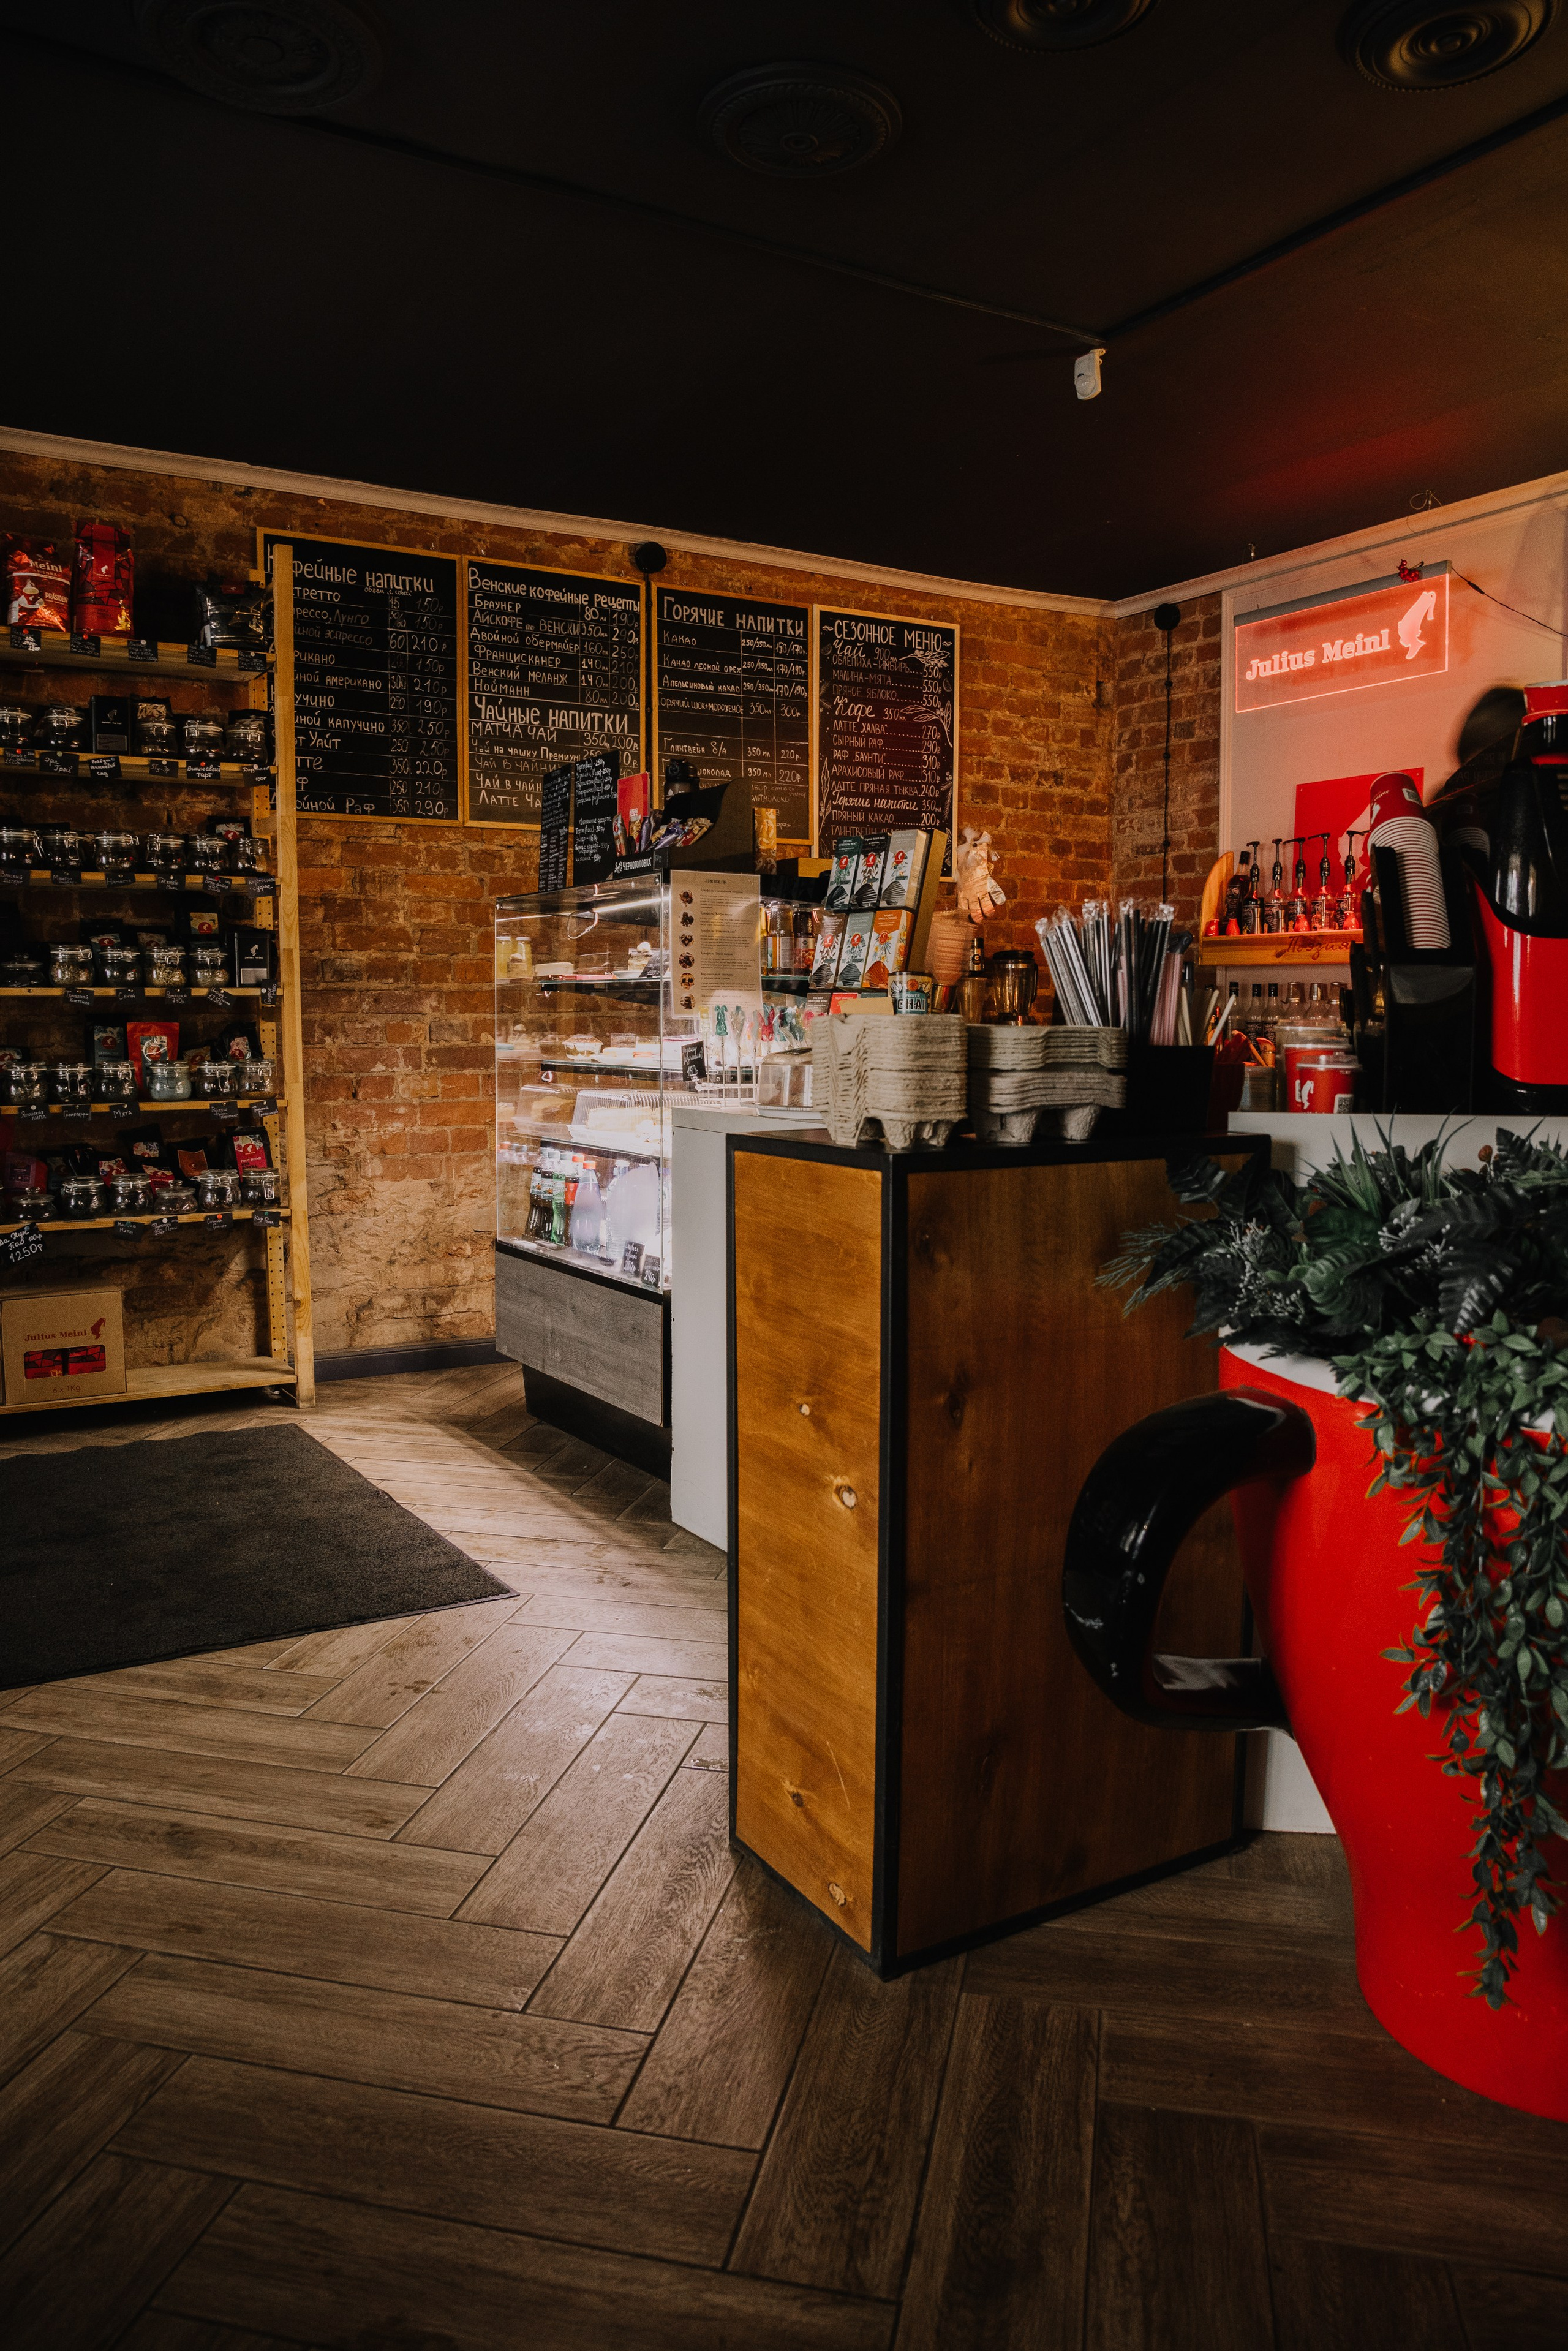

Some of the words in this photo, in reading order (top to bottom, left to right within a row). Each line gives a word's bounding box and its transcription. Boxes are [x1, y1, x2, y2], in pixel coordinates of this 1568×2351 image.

[29, 559, 63, 573] Meinl
[267, 543, 357, 584] фейные
[366, 571, 434, 593] напитки
[292, 586, 341, 602] третто
[390, 597, 400, 609] 15
[469, 567, 527, 595] Венские
[529, 587, 589, 605] кофейные
[594, 593, 641, 613] рецепты
[333, 609, 370, 626] Лунго
[663, 595, 725, 627] ГОРЯЧИЕ
[736, 613, 804, 637] НАПИТКИ
[325, 631, 373, 646] эспрессо
[390, 633, 405, 649] 60
[834, 619, 897, 646] СЕЗОННОЕ
[904, 629, 943, 652] МЕНЮ
[833, 639, 865, 658] Чай
[1245, 650, 1316, 681] Julius
[1321, 628, 1391, 663] Meinl
[473, 660, 520, 681] Венский
[413, 678, 448, 696] 210р
[832, 684, 862, 696] ПРЯНОЕ
[866, 687, 897, 701] ЯБЛОКО
[474, 695, 540, 725] Чайные
[833, 695, 875, 722] Кофе
[471, 722, 523, 739] МАТЧА
[527, 726, 557, 743] ЧАЙ
[833, 720, 858, 732] ЛАТТЕ
[309, 731, 342, 750] Уайт
[832, 734, 866, 749] СЫРНЫЙ
[869, 738, 884, 749] РАФ
[494, 745, 503, 754] на
[541, 747, 579, 761] Премиум
[833, 750, 849, 760] РАФ
[415, 760, 448, 776] 220р
[831, 764, 884, 779] АРАХИСОВЫЙ
[889, 770, 905, 781] РАФ
[831, 781, 856, 792] ЛАТТЕ
[859, 783, 890, 794] ПРЯНАЯ
[893, 785, 918, 796] ТЫКВА
[346, 797, 375, 815] Раф
[415, 801, 448, 816] 290р
[832, 790, 870, 810] Горячие
[873, 799, 918, 810] напитки
[831, 810, 865, 823] ПРЯНЫЙ
[869, 813, 894, 823] КАКАО
[622, 859, 652, 870] ЧЕРНОГОЛОВКА
[897, 998, 926, 1011] CHAI
[10, 1243, 43, 1262] 1250р
[24, 1333, 56, 1342] Julius
